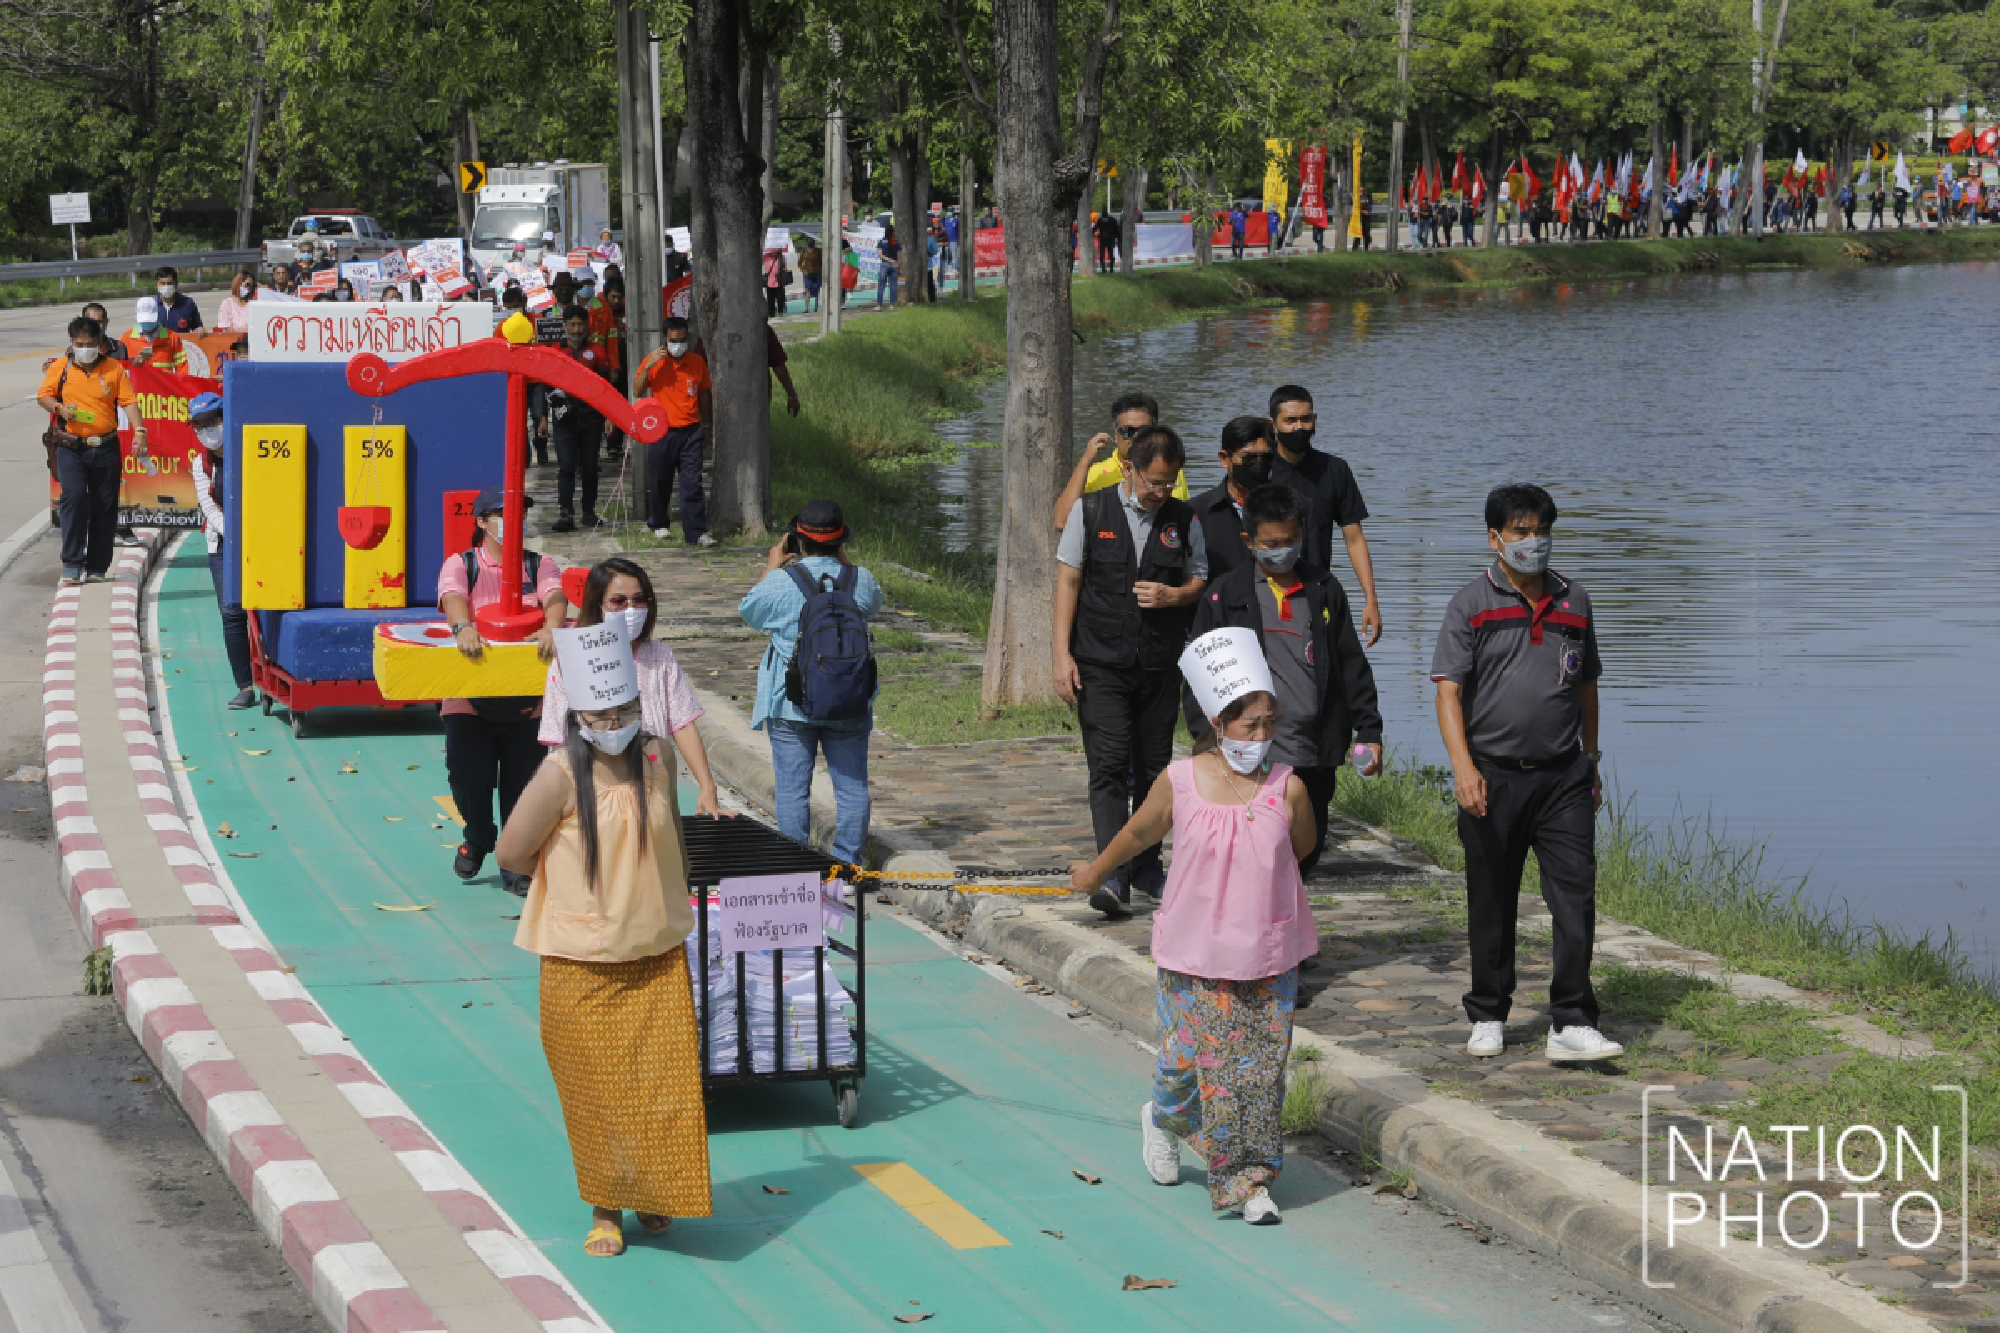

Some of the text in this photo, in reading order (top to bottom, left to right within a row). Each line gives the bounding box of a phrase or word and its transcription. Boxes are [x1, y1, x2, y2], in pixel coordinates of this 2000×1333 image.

[257, 439, 291, 459] 5%
[361, 439, 394, 459] 5%
[724, 882, 816, 908] เอกสารเข้าชื่อ
[733, 920, 808, 941] ฟ้องรัฐบาล
